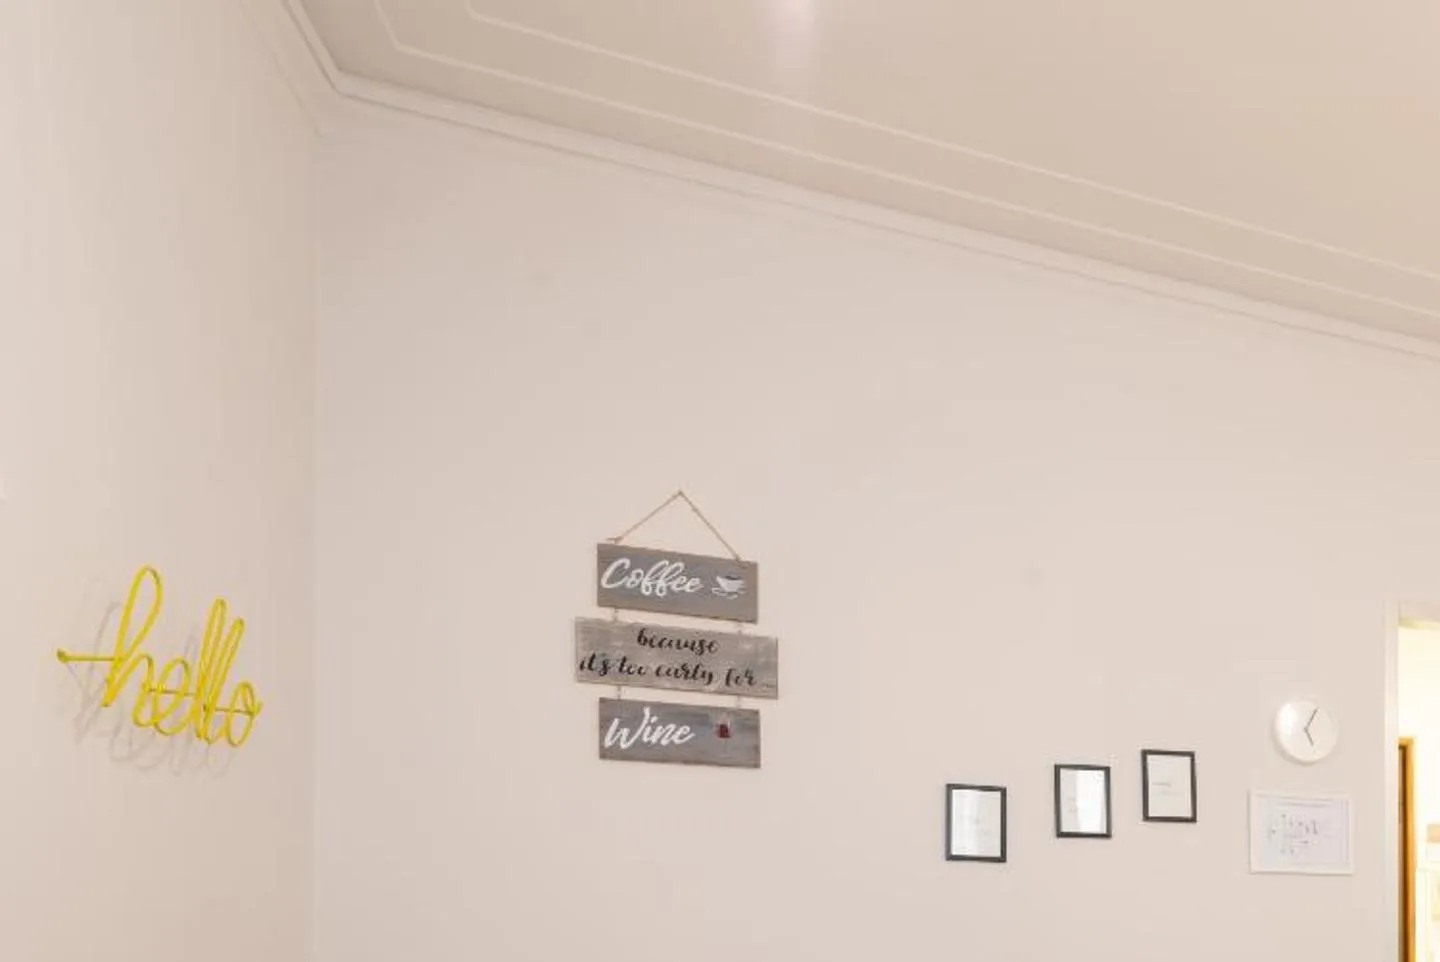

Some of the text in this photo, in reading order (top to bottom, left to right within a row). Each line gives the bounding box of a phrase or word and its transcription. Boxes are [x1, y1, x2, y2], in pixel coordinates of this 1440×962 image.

[600, 557, 704, 597] Coffee
[56, 564, 263, 747] hello
[636, 627, 719, 656] because
[579, 653, 757, 687] it's too early for
[604, 707, 695, 750] Wine
